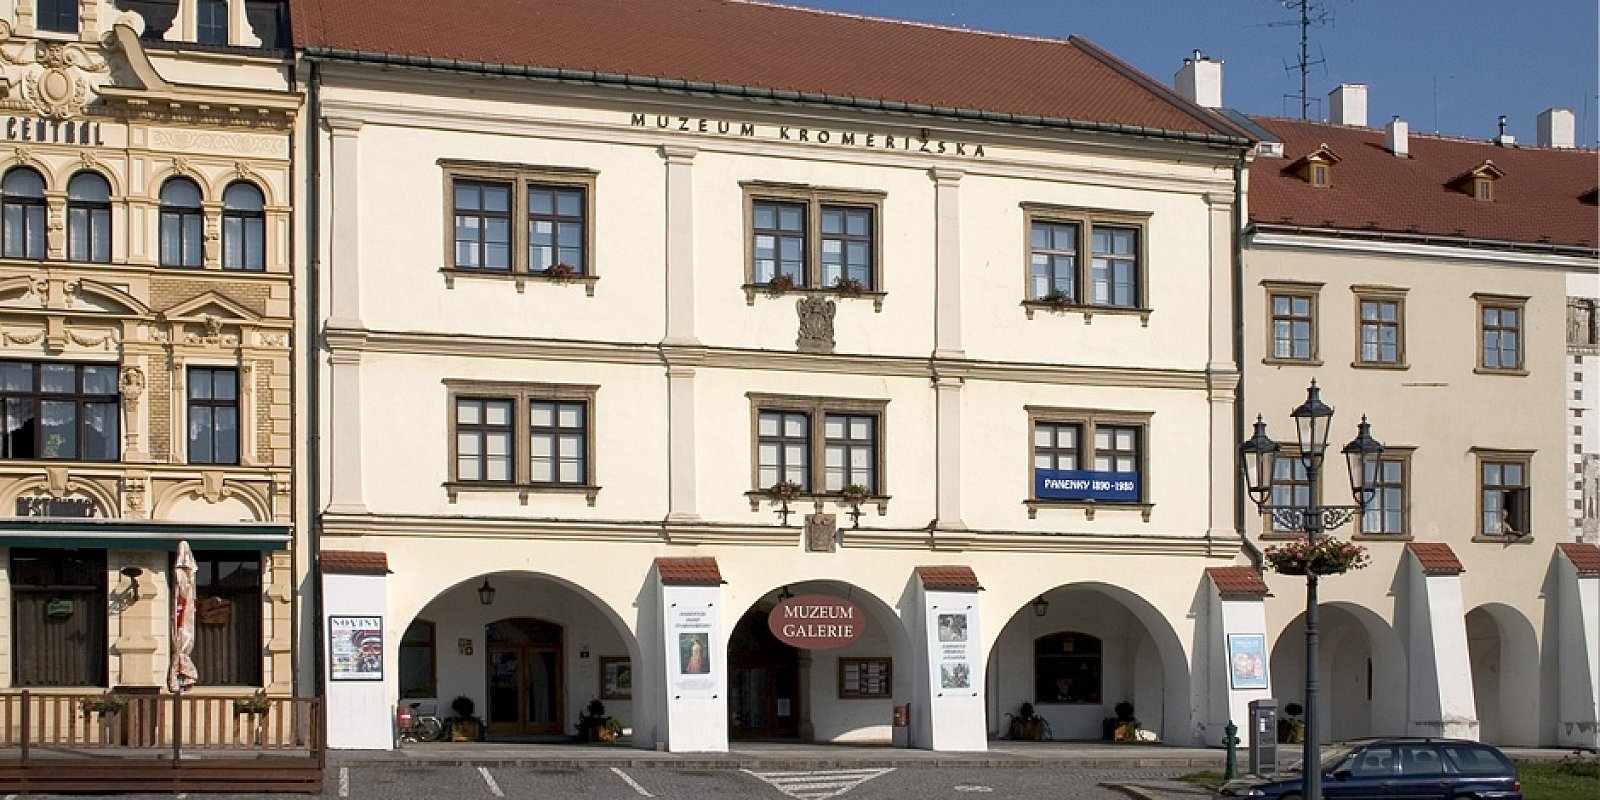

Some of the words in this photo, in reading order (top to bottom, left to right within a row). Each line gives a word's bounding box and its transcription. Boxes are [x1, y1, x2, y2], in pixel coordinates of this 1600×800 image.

[7, 116, 104, 146] CENTRAL
[631, 113, 755, 137] MUZEUM
[1044, 479, 1090, 490] PANENKY
[784, 605, 853, 619] MUZEUM
[783, 624, 853, 637] GALERIE
